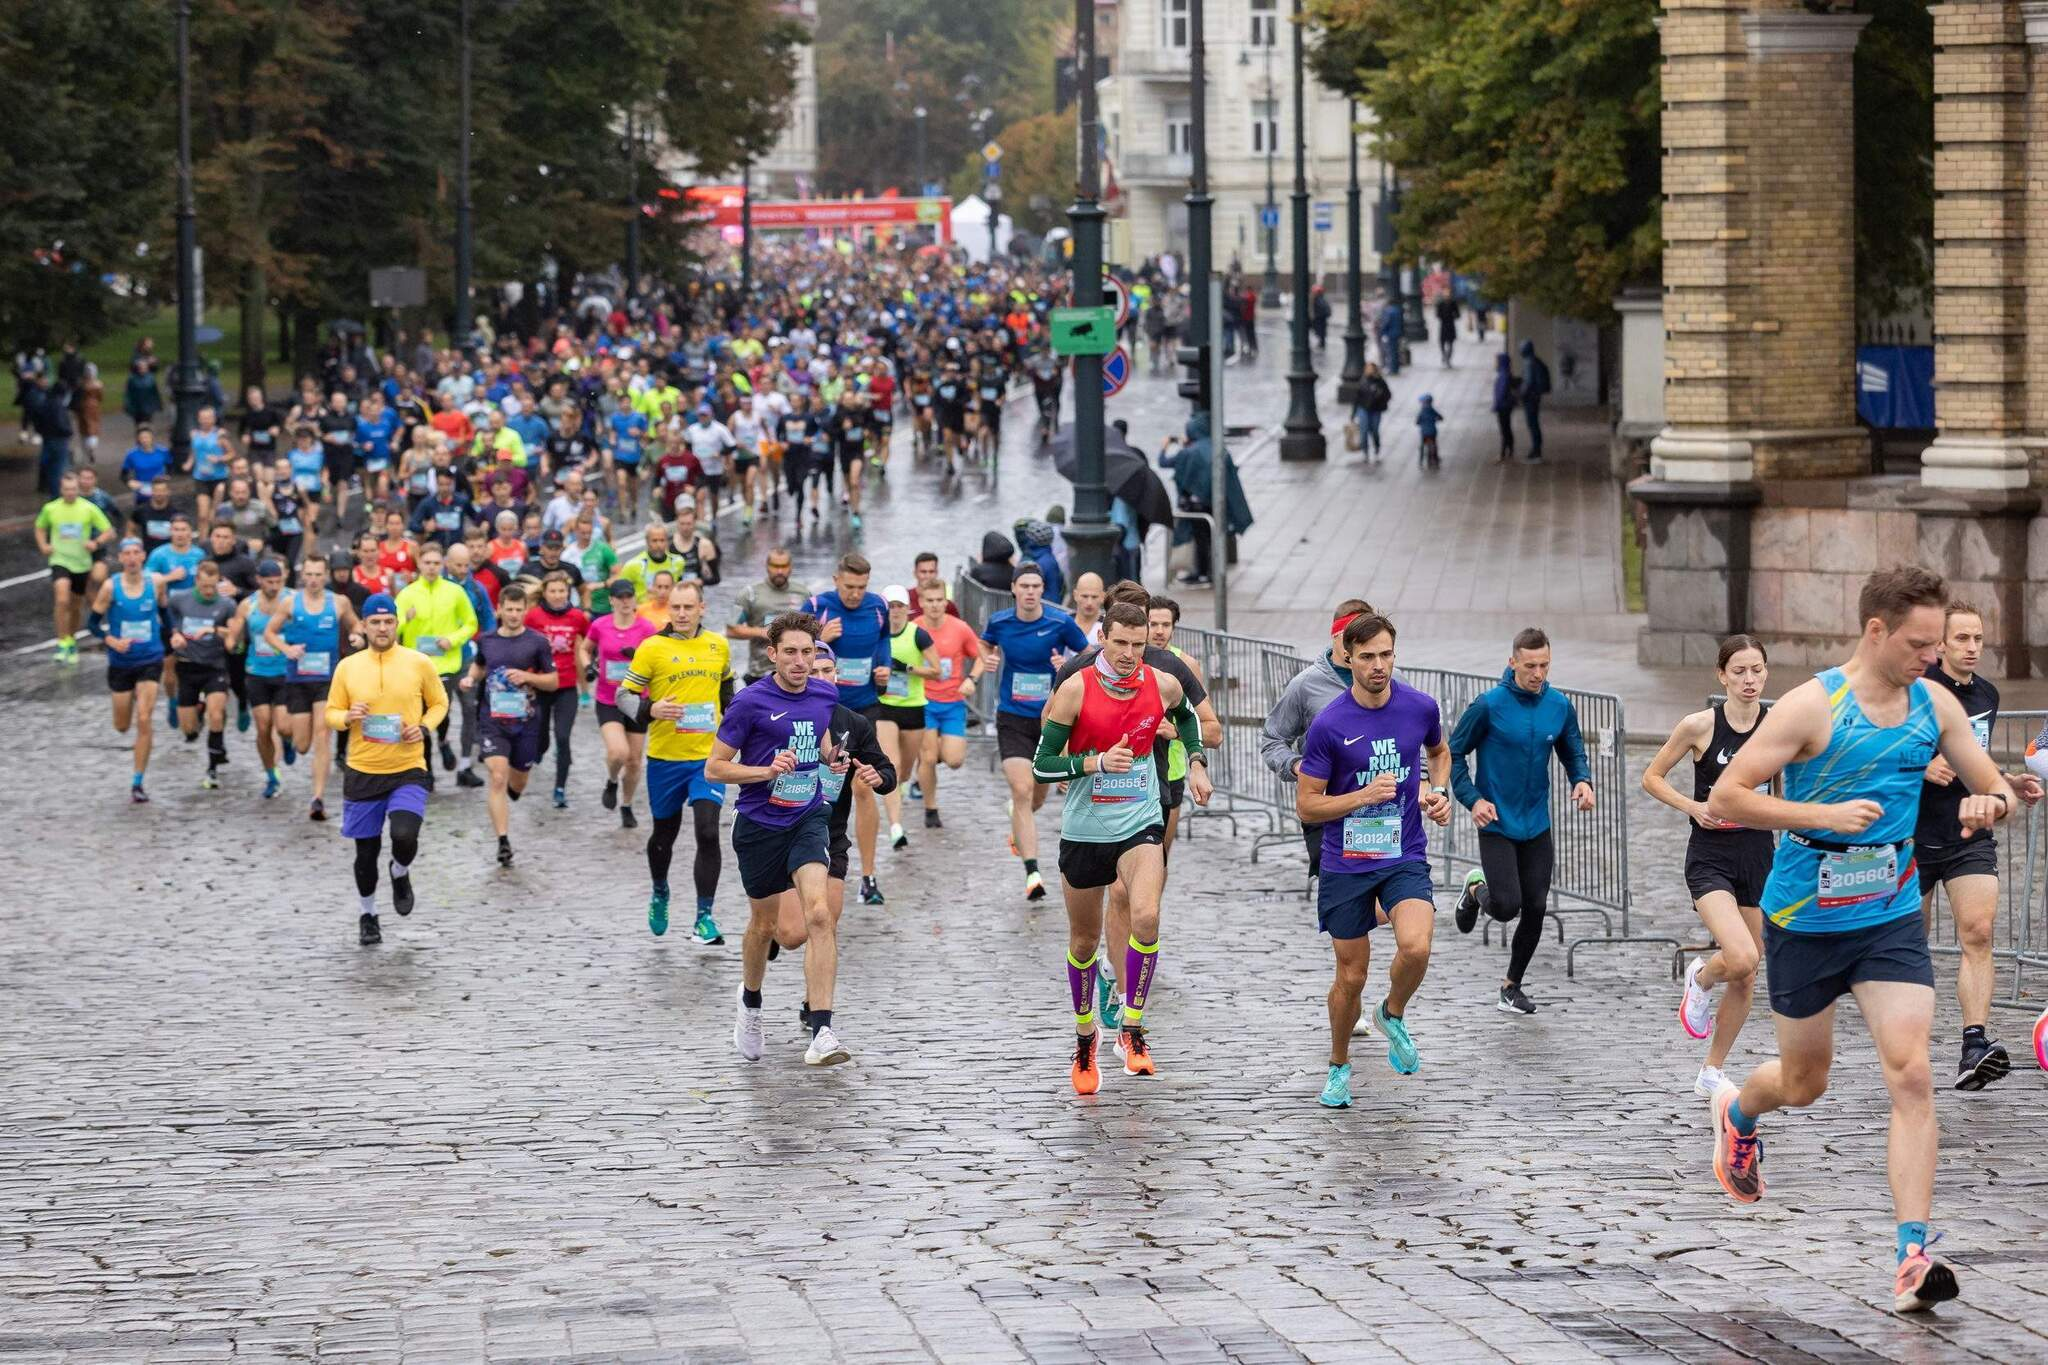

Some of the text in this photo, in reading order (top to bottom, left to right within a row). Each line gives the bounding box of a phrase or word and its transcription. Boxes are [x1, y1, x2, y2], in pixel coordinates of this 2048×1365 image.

[792, 720, 814, 736] WE
[788, 735, 818, 750] RUN
[1371, 738, 1397, 756] WE
[1369, 753, 1401, 771] RUN
[1103, 778, 1141, 789] 20555
[1355, 832, 1392, 844] 20124
